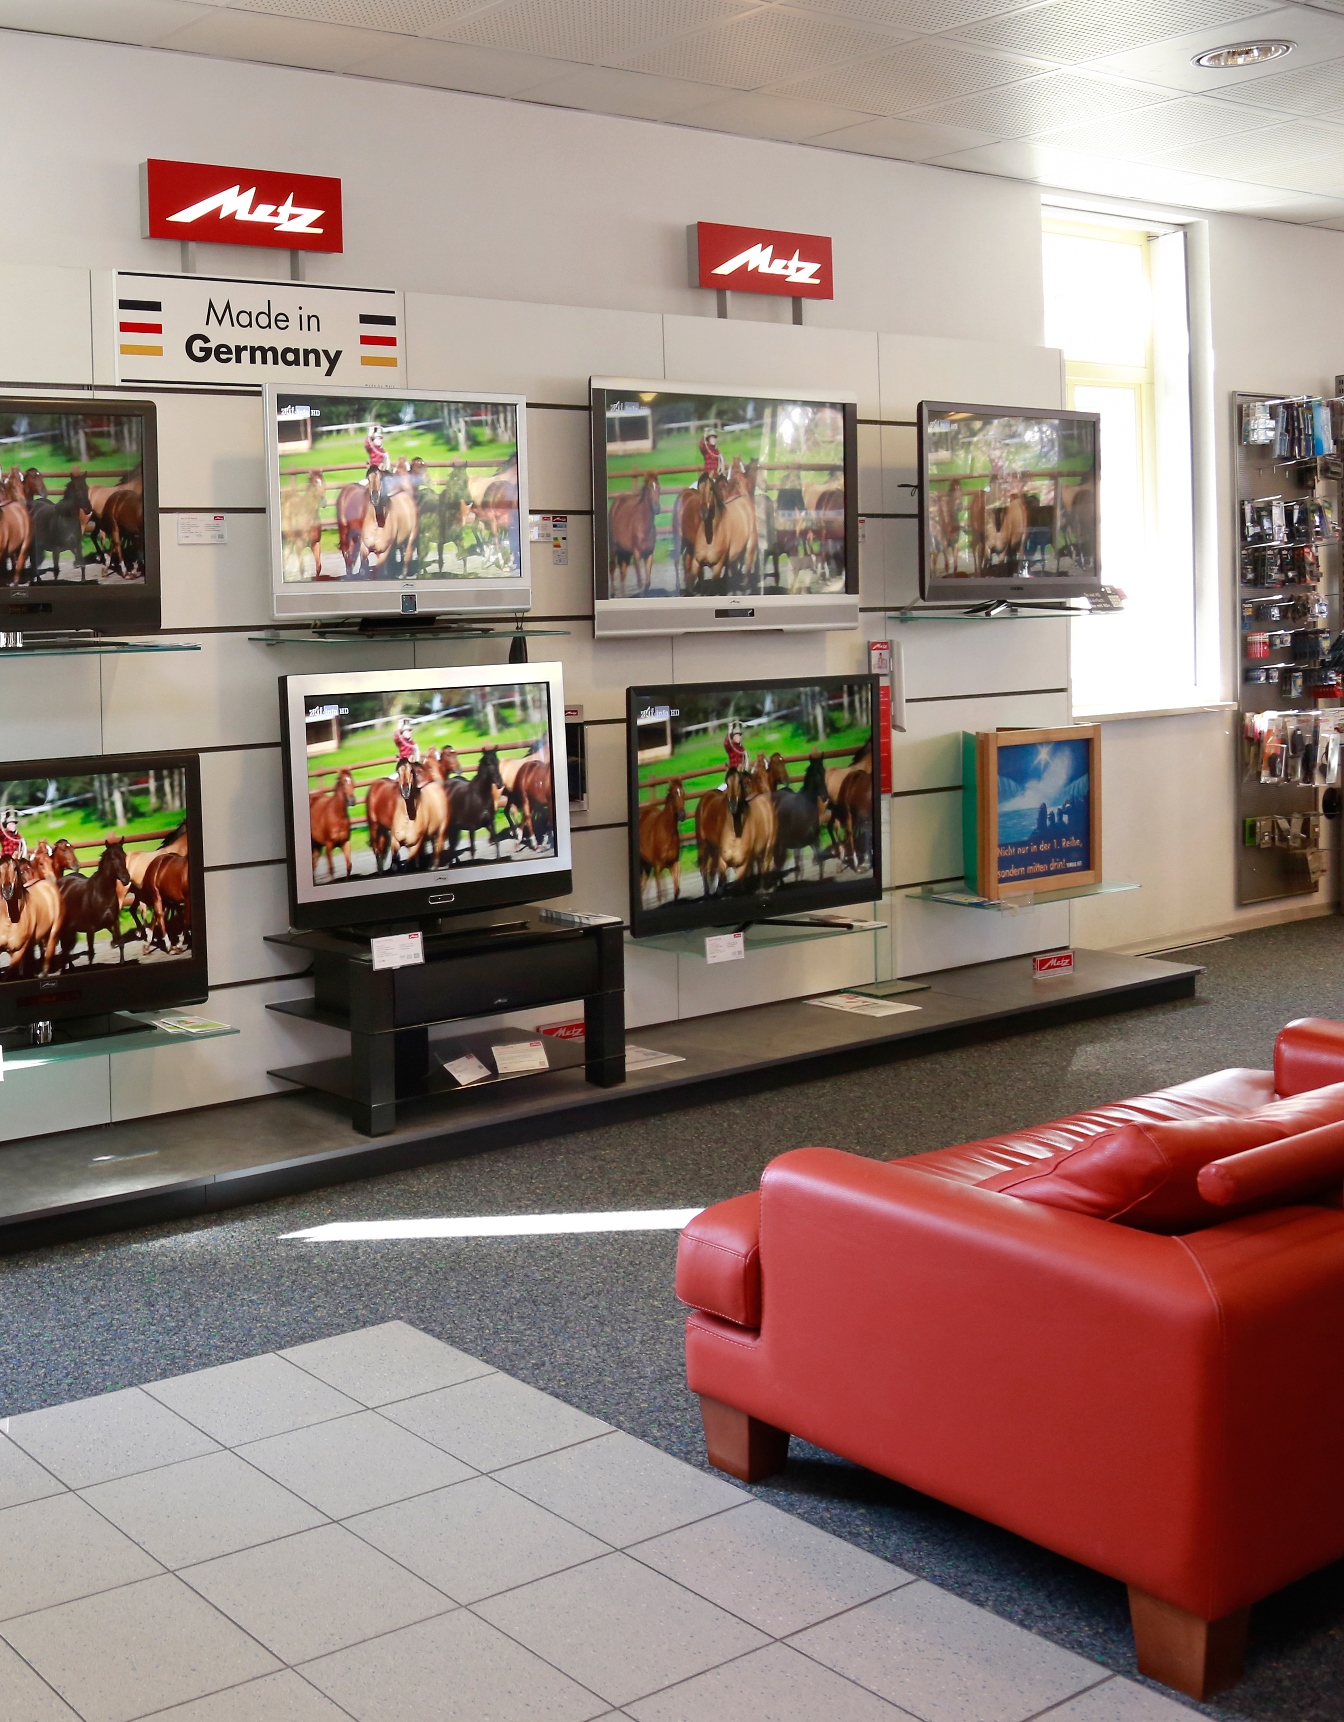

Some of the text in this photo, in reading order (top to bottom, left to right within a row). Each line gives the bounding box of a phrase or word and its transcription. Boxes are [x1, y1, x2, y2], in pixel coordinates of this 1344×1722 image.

[165, 184, 326, 234] Metz
[710, 243, 822, 285] Metz
[205, 298, 322, 332] Made in
[184, 333, 343, 377] Germany
[311, 409, 321, 417] HD
[1017, 846, 1029, 854] nur
[1030, 842, 1038, 852] in
[1040, 840, 1051, 851] der
[1053, 839, 1060, 849] 1.
[1061, 836, 1083, 848] Reihe,
[997, 864, 1025, 878] sondern
[1027, 862, 1048, 874] mitten
[1049, 858, 1066, 871] drin!
[1041, 957, 1070, 970] Metz
[554, 1026, 584, 1037] Metz
